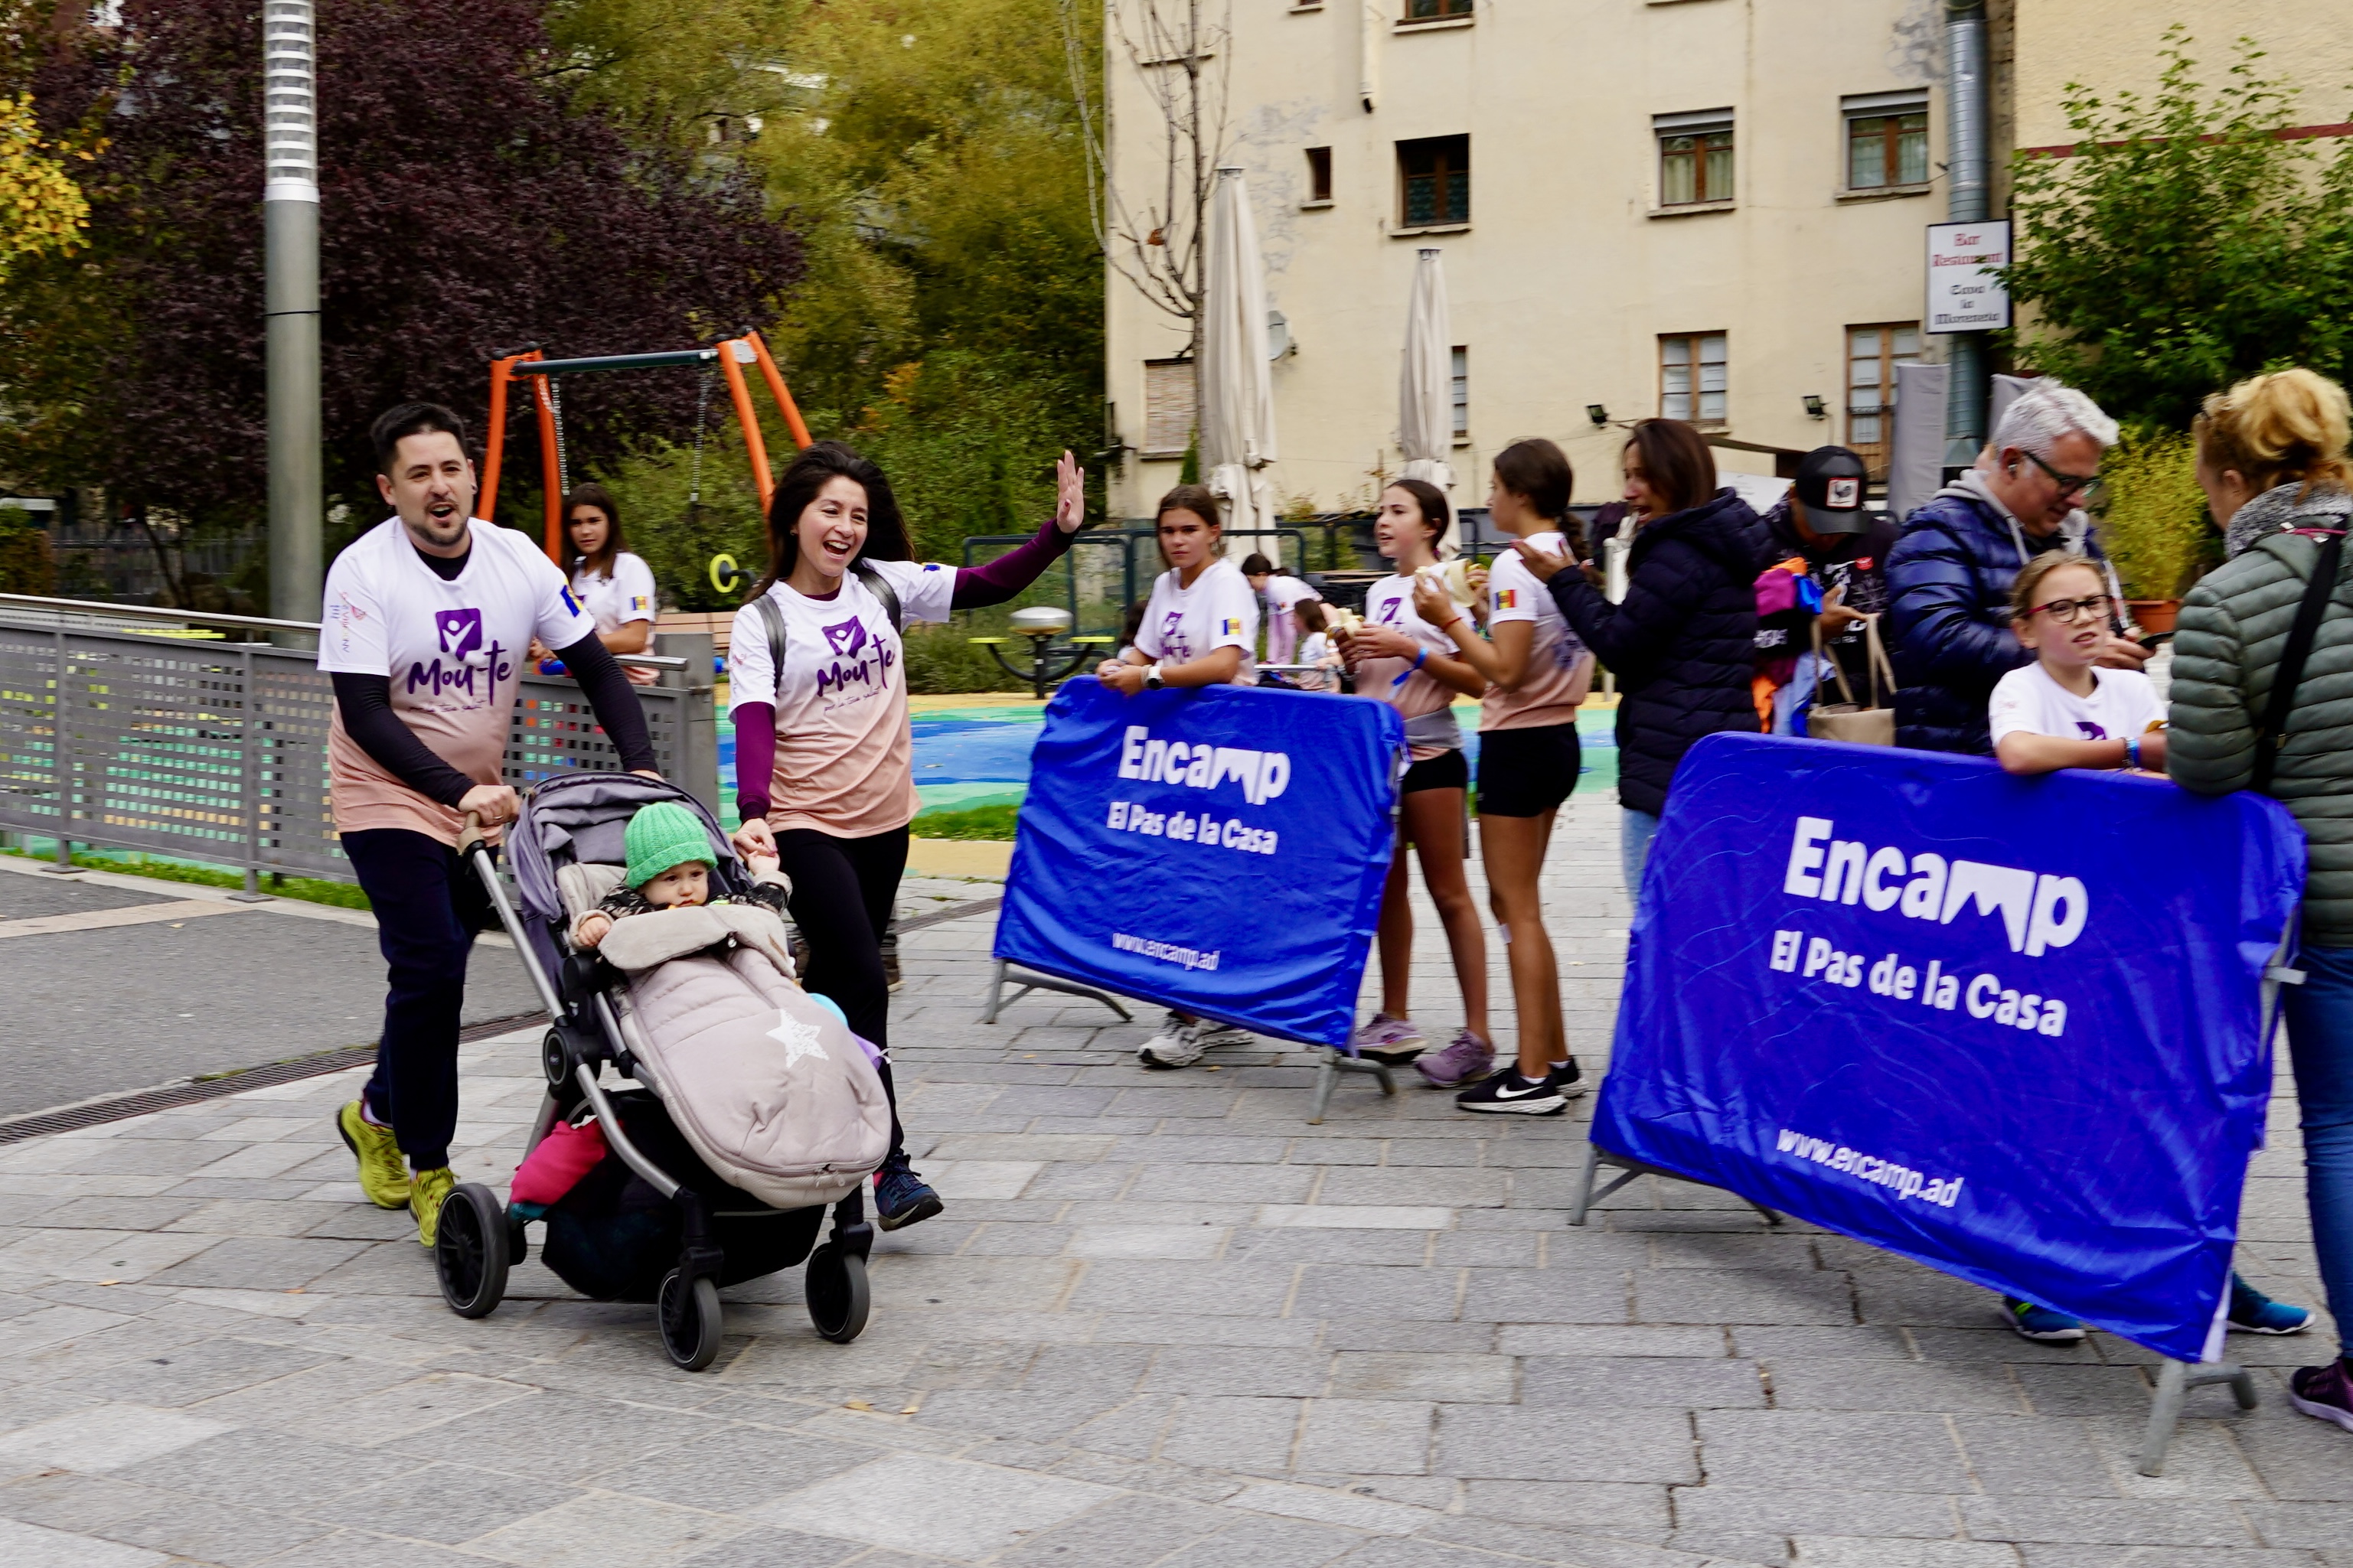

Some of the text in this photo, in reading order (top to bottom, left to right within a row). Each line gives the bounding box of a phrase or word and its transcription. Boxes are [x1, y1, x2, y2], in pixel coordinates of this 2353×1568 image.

[1954, 233, 1981, 246] Bar
[1118, 725, 1291, 806] Encamp
[1106, 801, 1278, 855] El Pas de la Casa
[1783, 816, 2088, 957] Encamp
[1113, 931, 1221, 971] www.encamp.ad
[1769, 930, 2067, 1037] El Pas de la Casa
[1776, 1129, 1965, 1209] www.encamp.ad
